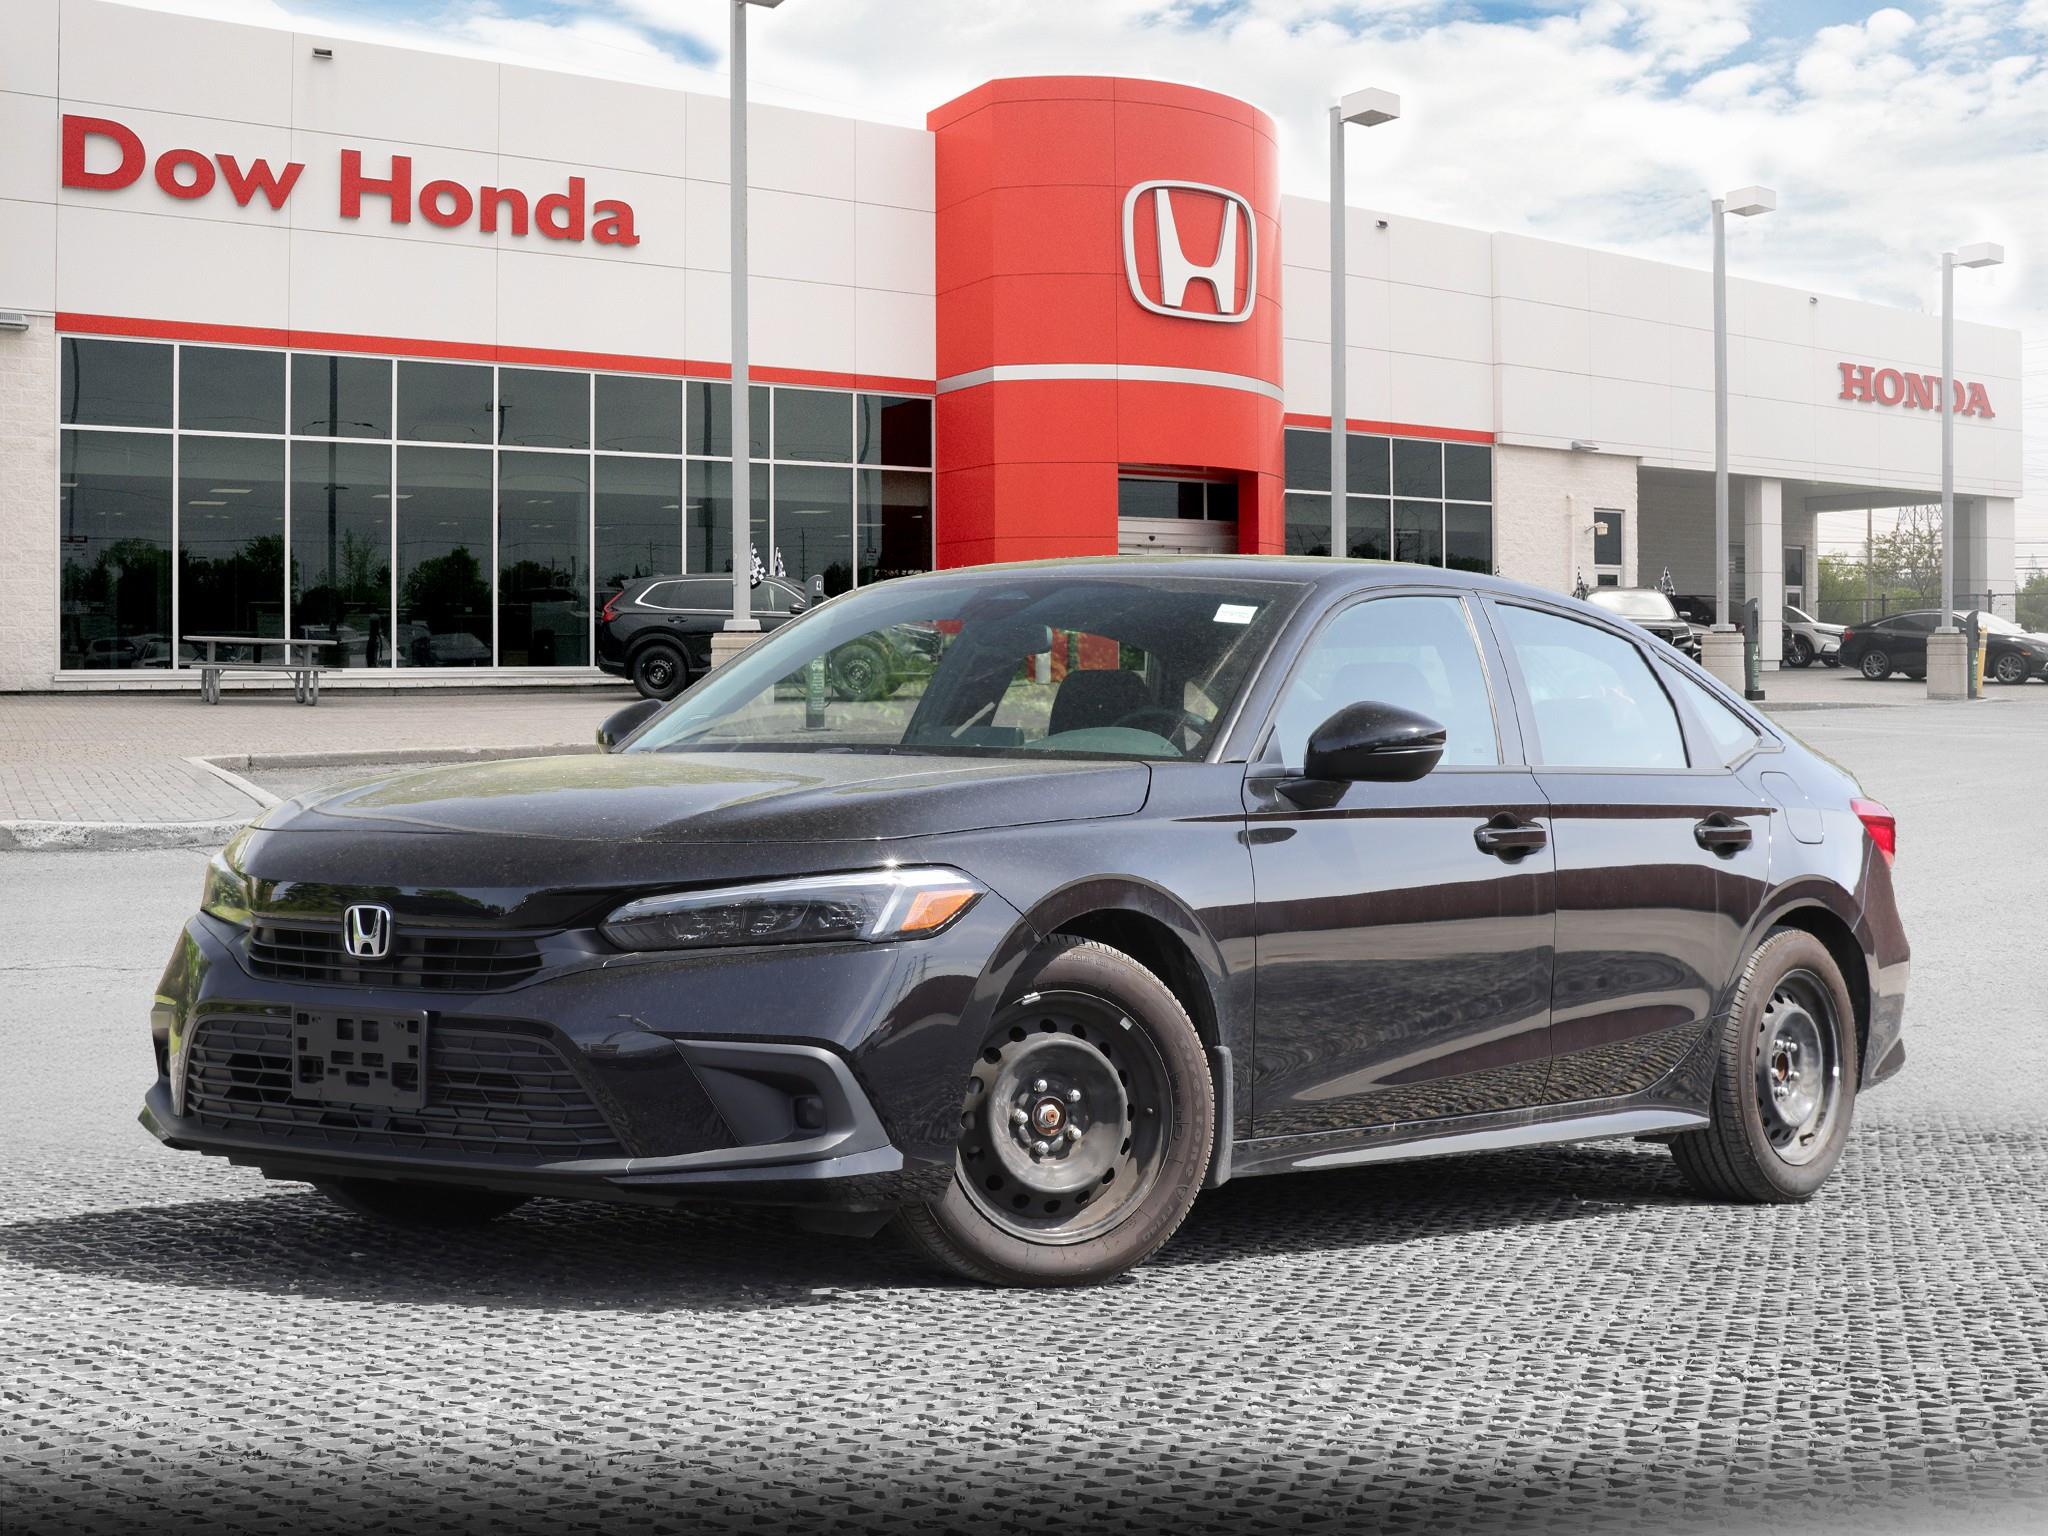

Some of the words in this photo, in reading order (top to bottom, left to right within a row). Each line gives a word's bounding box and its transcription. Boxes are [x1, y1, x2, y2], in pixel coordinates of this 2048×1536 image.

[62, 114, 305, 210] Dow
[340, 149, 640, 247] Honda
[1838, 362, 1996, 418] HONDA
